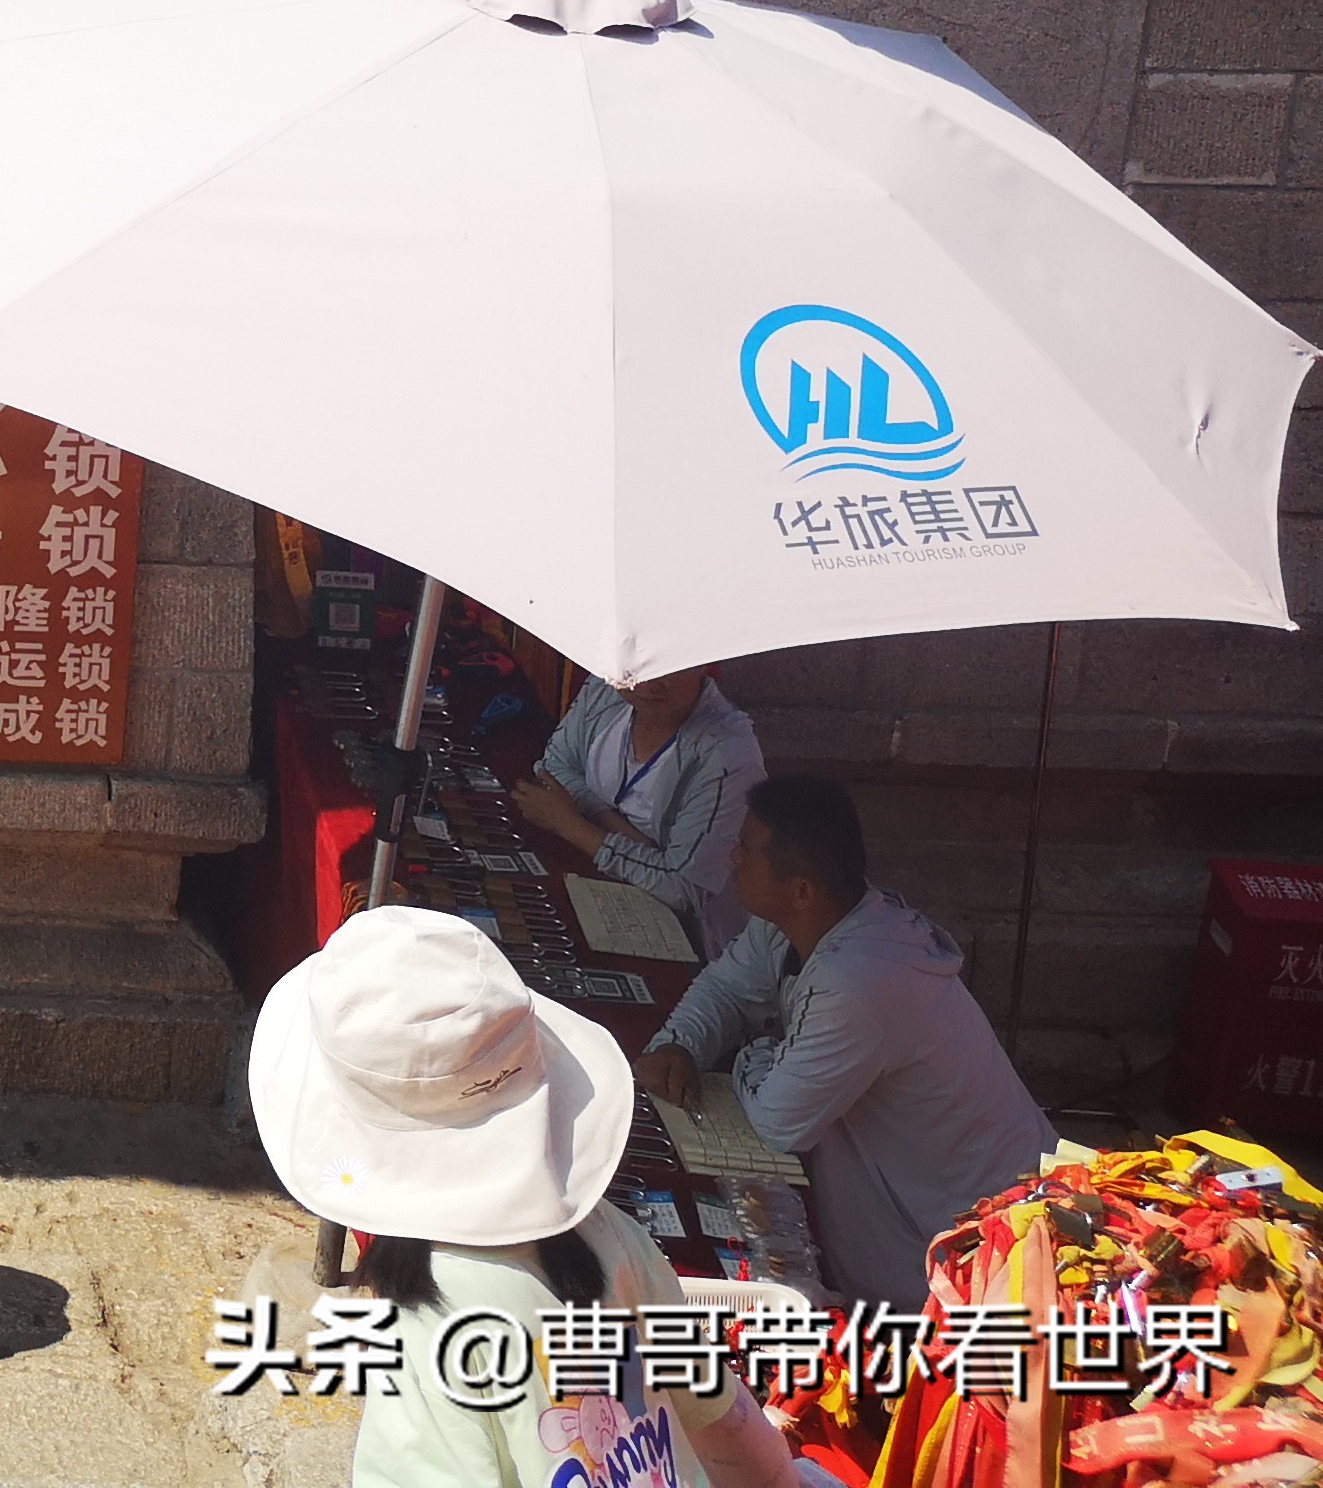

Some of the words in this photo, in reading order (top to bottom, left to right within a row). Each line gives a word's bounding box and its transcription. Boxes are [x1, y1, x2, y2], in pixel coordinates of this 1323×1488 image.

[773, 485, 1040, 555] 华旅集团
[811, 554, 890, 571] HUASHAN
[892, 547, 967, 564] TOURISM
[969, 543, 1027, 558] GROUP
[1238, 873, 1323, 902] 消防器材
[1240, 1054, 1323, 1098] 火警1
